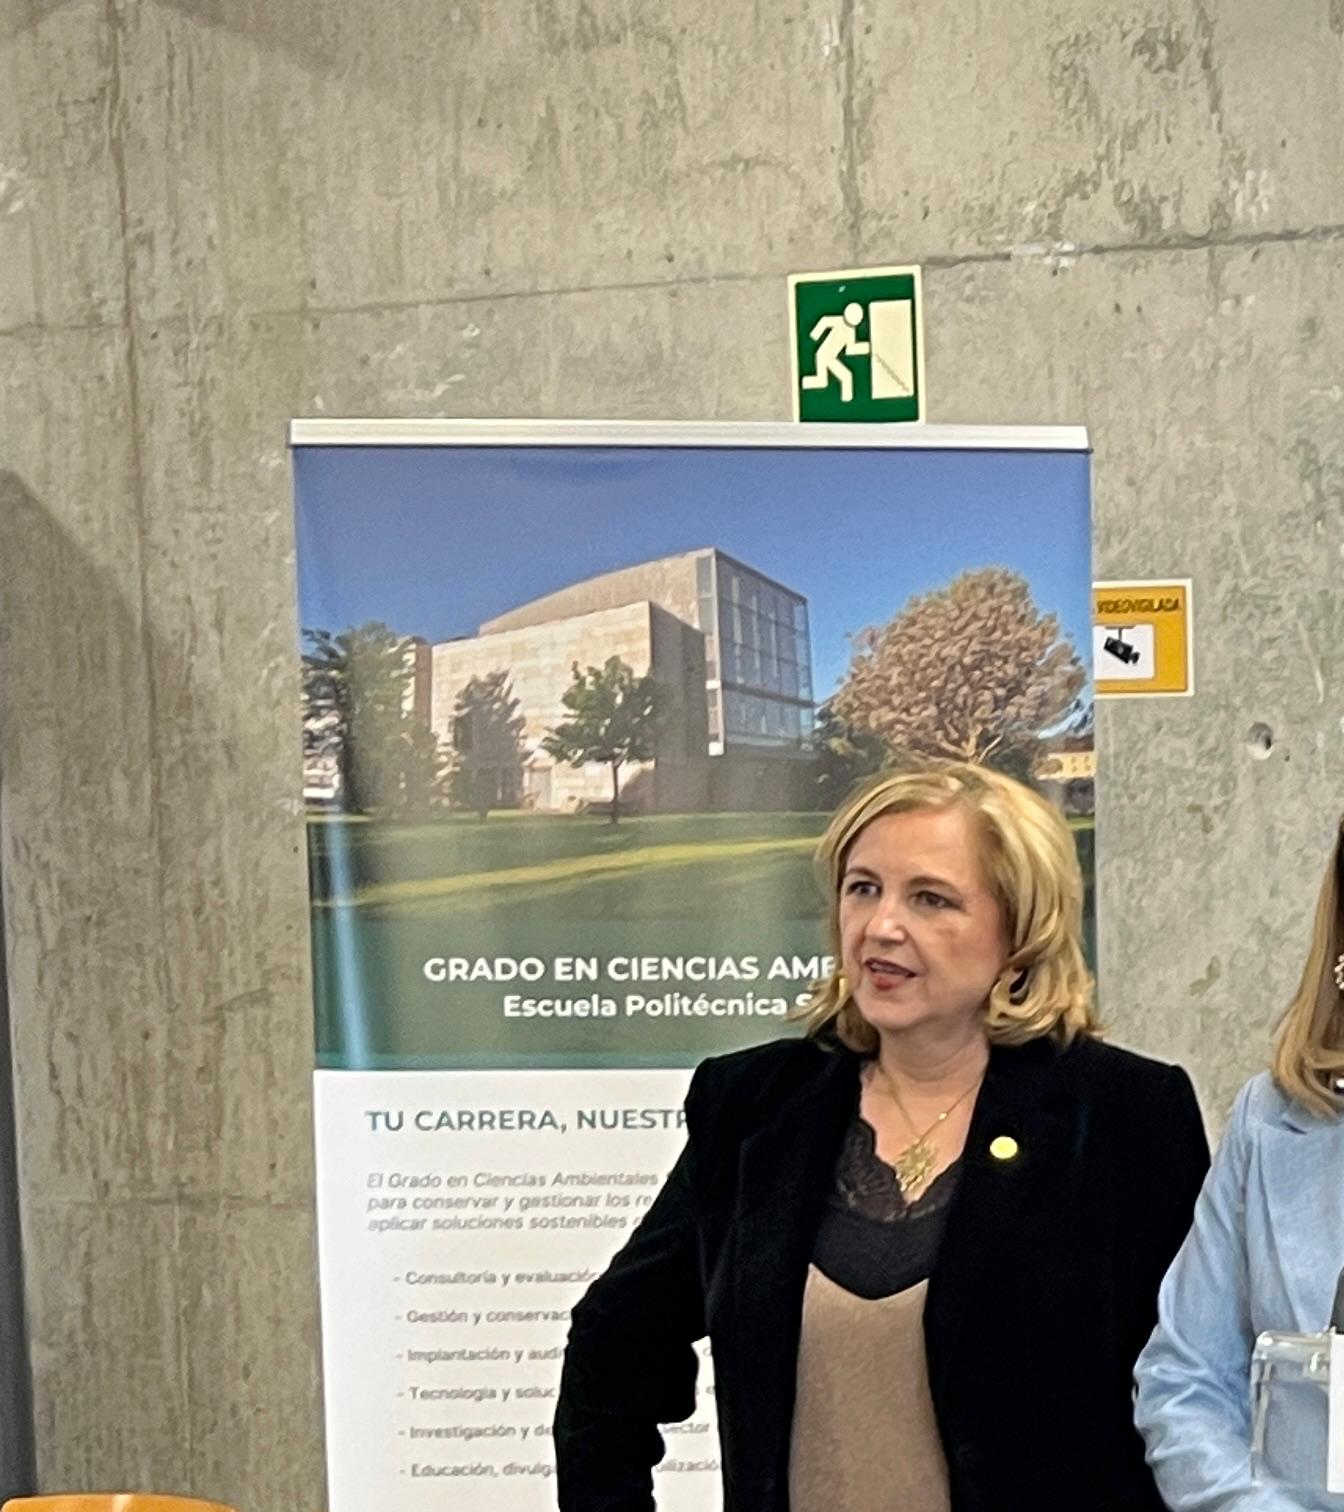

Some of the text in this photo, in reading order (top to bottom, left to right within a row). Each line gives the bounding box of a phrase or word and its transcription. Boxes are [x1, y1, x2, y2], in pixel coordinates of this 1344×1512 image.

[423, 957, 544, 981] GRADO
[555, 956, 599, 981] EN
[608, 957, 760, 981] CIENCIAS
[503, 996, 617, 1016] Escuela
[626, 993, 787, 1016] Politécnica
[365, 1110, 403, 1131] TU
[414, 1110, 567, 1133] CARRERA,
[367, 1171, 658, 1188] El Grado en Ciencias Ambientales
[367, 1198, 407, 1214] para
[412, 1196, 500, 1211] conservar
[504, 1197, 514, 1212] y
[519, 1193, 601, 1212] gestionar
[606, 1192, 631, 1207] los
[368, 1212, 629, 1233] aplicar soluciones sostenibles
[405, 1270, 497, 1285] Consultoría
[502, 1273, 511, 1287] y
[406, 1310, 469, 1323] Gestión
[473, 1312, 482, 1326] y
[408, 1348, 510, 1363] Implantación
[515, 1350, 524, 1364] y
[409, 1386, 497, 1401] Tecnología
[502, 1388, 511, 1402] y
[410, 1425, 516, 1441] Investigación
[521, 1426, 530, 1440] y
